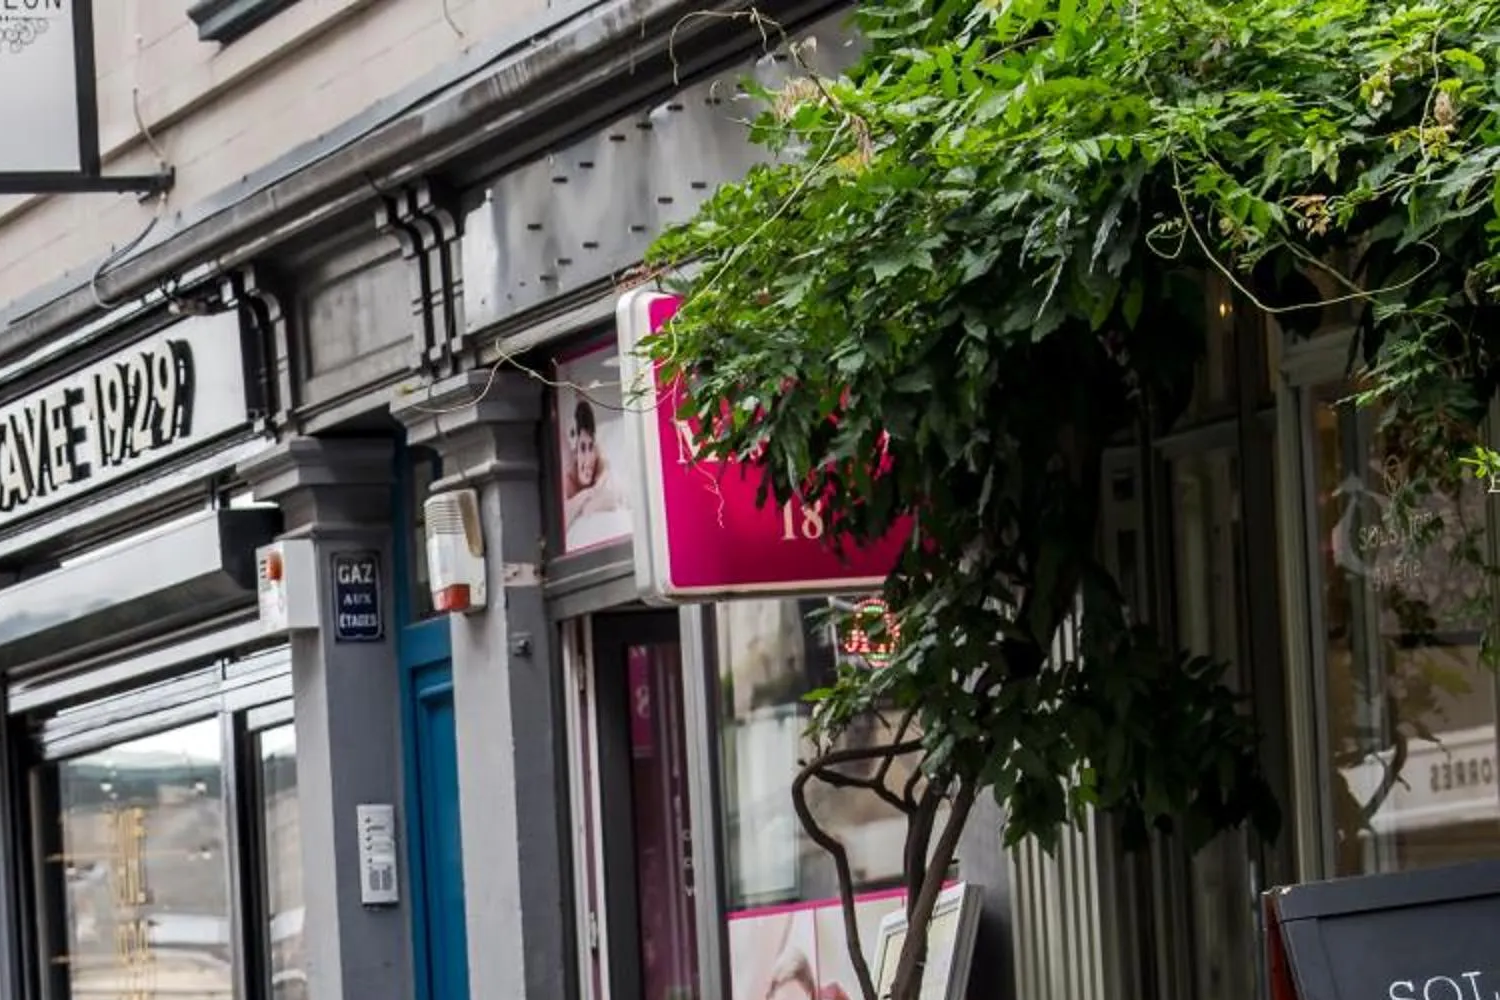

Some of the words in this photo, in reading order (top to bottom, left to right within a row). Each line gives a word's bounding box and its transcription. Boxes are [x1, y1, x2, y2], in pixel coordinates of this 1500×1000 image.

[90, 339, 196, 466] 1929
[338, 563, 373, 585] GAZ
[343, 593, 372, 606] AUX
